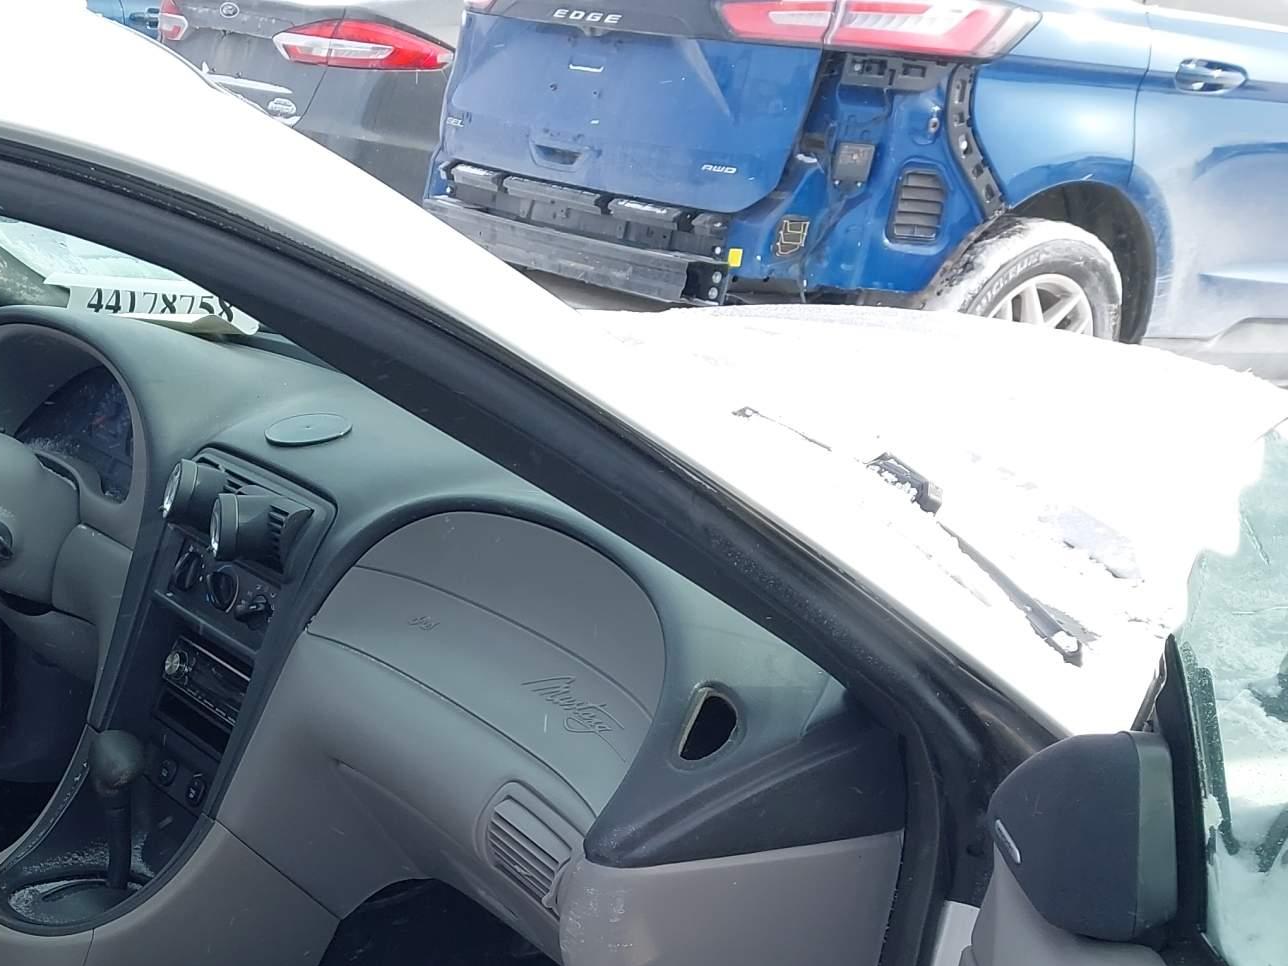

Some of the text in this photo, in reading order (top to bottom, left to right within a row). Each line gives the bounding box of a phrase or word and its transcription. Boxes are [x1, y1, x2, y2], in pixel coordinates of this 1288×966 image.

[552, 8, 623, 24] EDGE
[701, 164, 737, 174] AWD
[86, 287, 234, 323] 44178758
